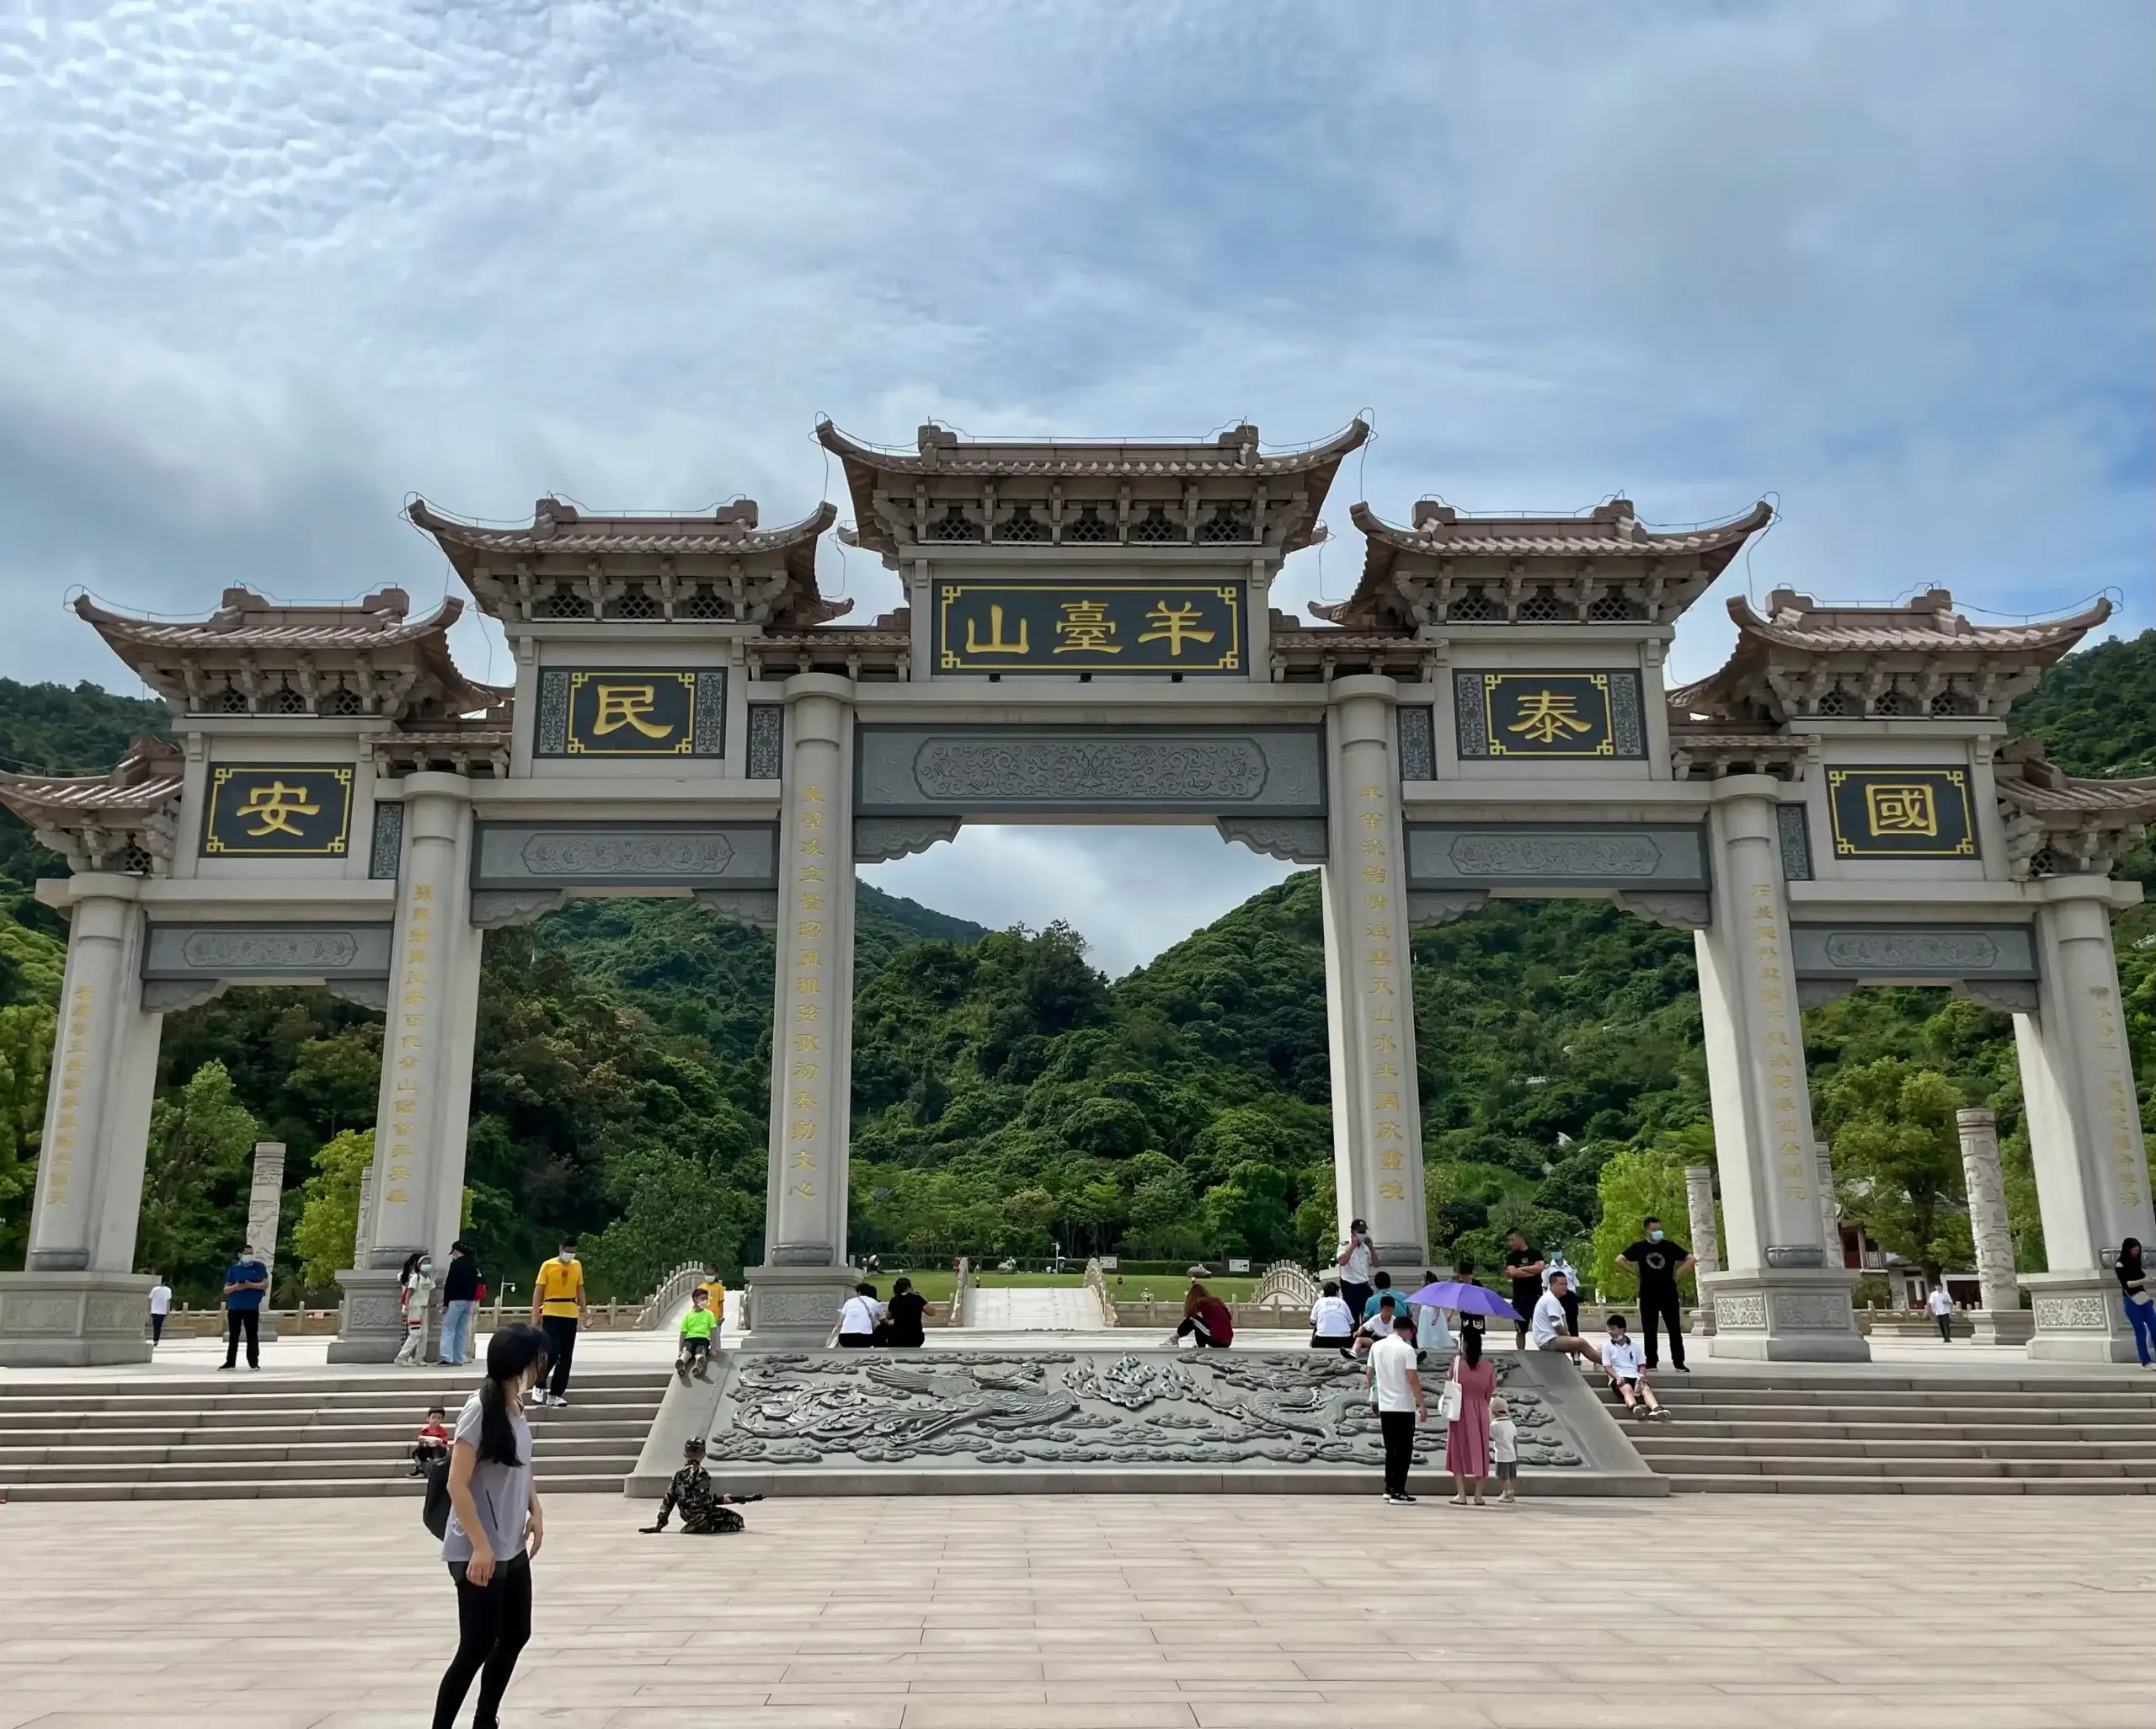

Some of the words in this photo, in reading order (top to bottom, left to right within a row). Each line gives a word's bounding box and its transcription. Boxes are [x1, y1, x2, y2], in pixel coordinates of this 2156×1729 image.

[593, 684, 674, 739] 民
[1508, 689, 1592, 743] 泰
[236, 781, 320, 836] 安
[1865, 783, 1937, 836] 國
